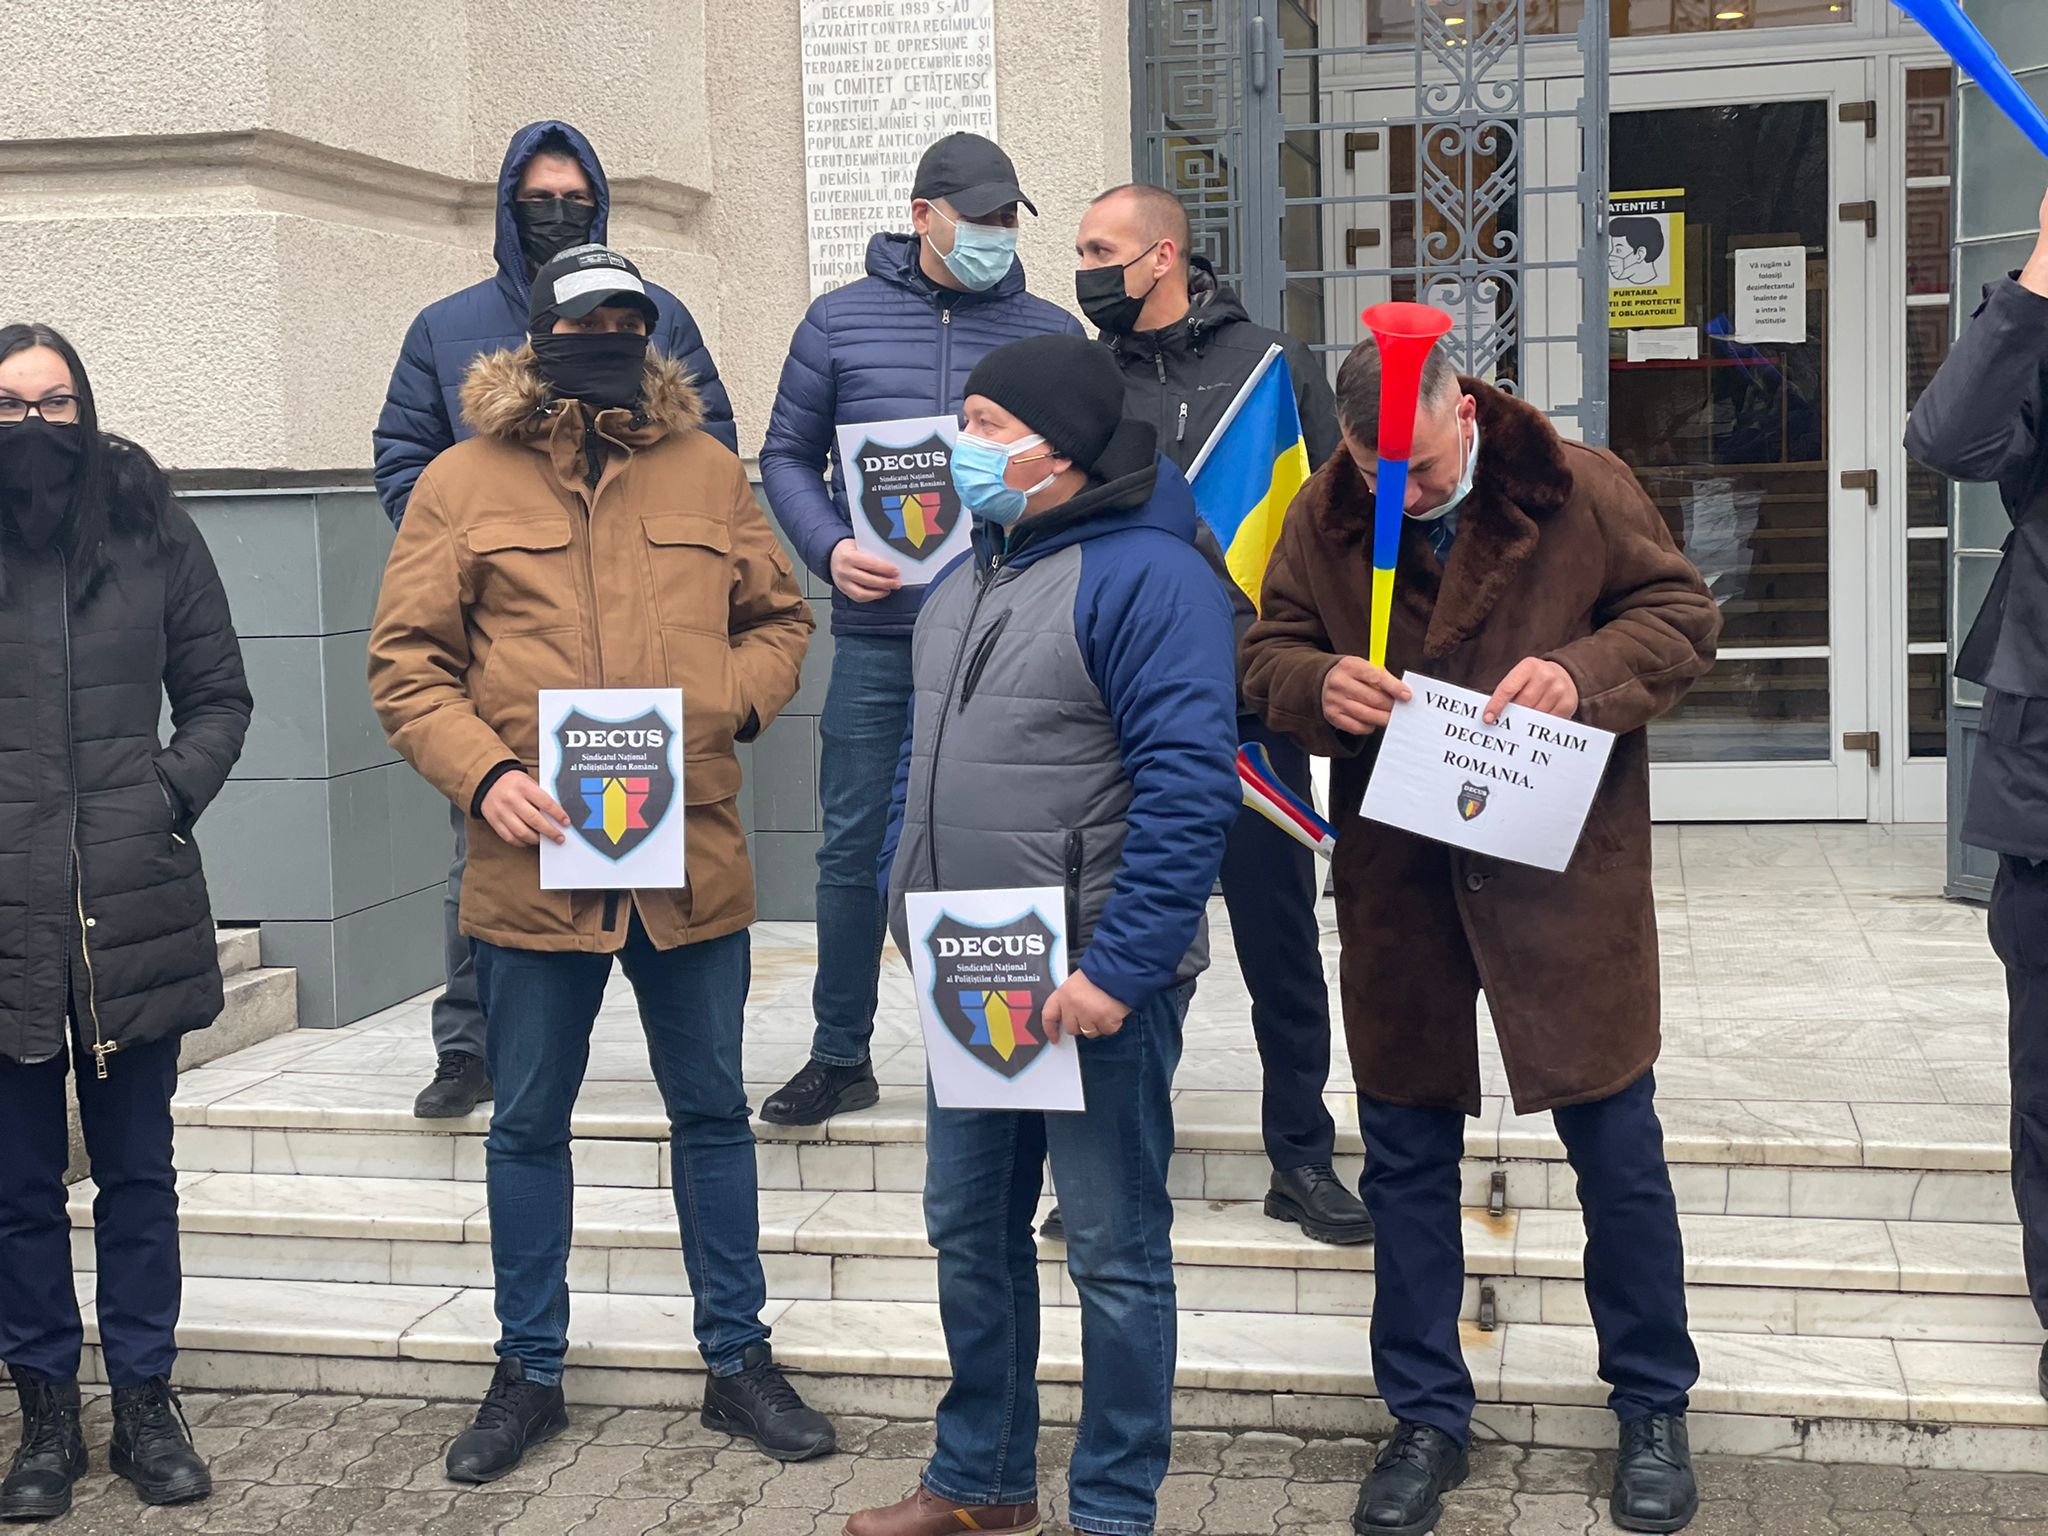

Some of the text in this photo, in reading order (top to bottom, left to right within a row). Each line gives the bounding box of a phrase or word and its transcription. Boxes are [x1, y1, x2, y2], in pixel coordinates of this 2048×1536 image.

[901, 2, 929, 15] 1989
[936, 0, 969, 14] S-AU
[871, 20, 920, 35] CONTRA
[875, 40, 890, 53] DE
[876, 58, 891, 71] 20
[965, 53, 992, 68] 1989
[808, 83, 824, 96] UN
[834, 73, 893, 95] COMITET
[890, 98, 907, 111] AD
[808, 135, 873, 150] POPULARE
[820, 168, 871, 186] DEMISIA
[815, 205, 884, 221] ELIBEREZE
[1613, 289, 1658, 297] PURTAREA
[1746, 282, 1795, 291] dezinfectantul
[862, 451, 947, 472] DECUS
[879, 473, 909, 483] Sindicatul
[909, 481, 920, 489] din
[1425, 690, 1478, 720] VREM
[1527, 722, 1587, 752] TRAIM
[565, 729, 664, 748] DECUS
[1444, 722, 1552, 767] DECENT IN
[581, 752, 617, 761] Sindicatul
[570, 763, 577, 771] al
[615, 763, 627, 771] din
[1443, 750, 1534, 790] ROMANIA.
[1463, 785, 1488, 797] DECUS
[936, 934, 1046, 958] DECUS
[956, 963, 993, 972] Sindicatul
[946, 975, 953, 983] al
[993, 974, 1006, 983] din
